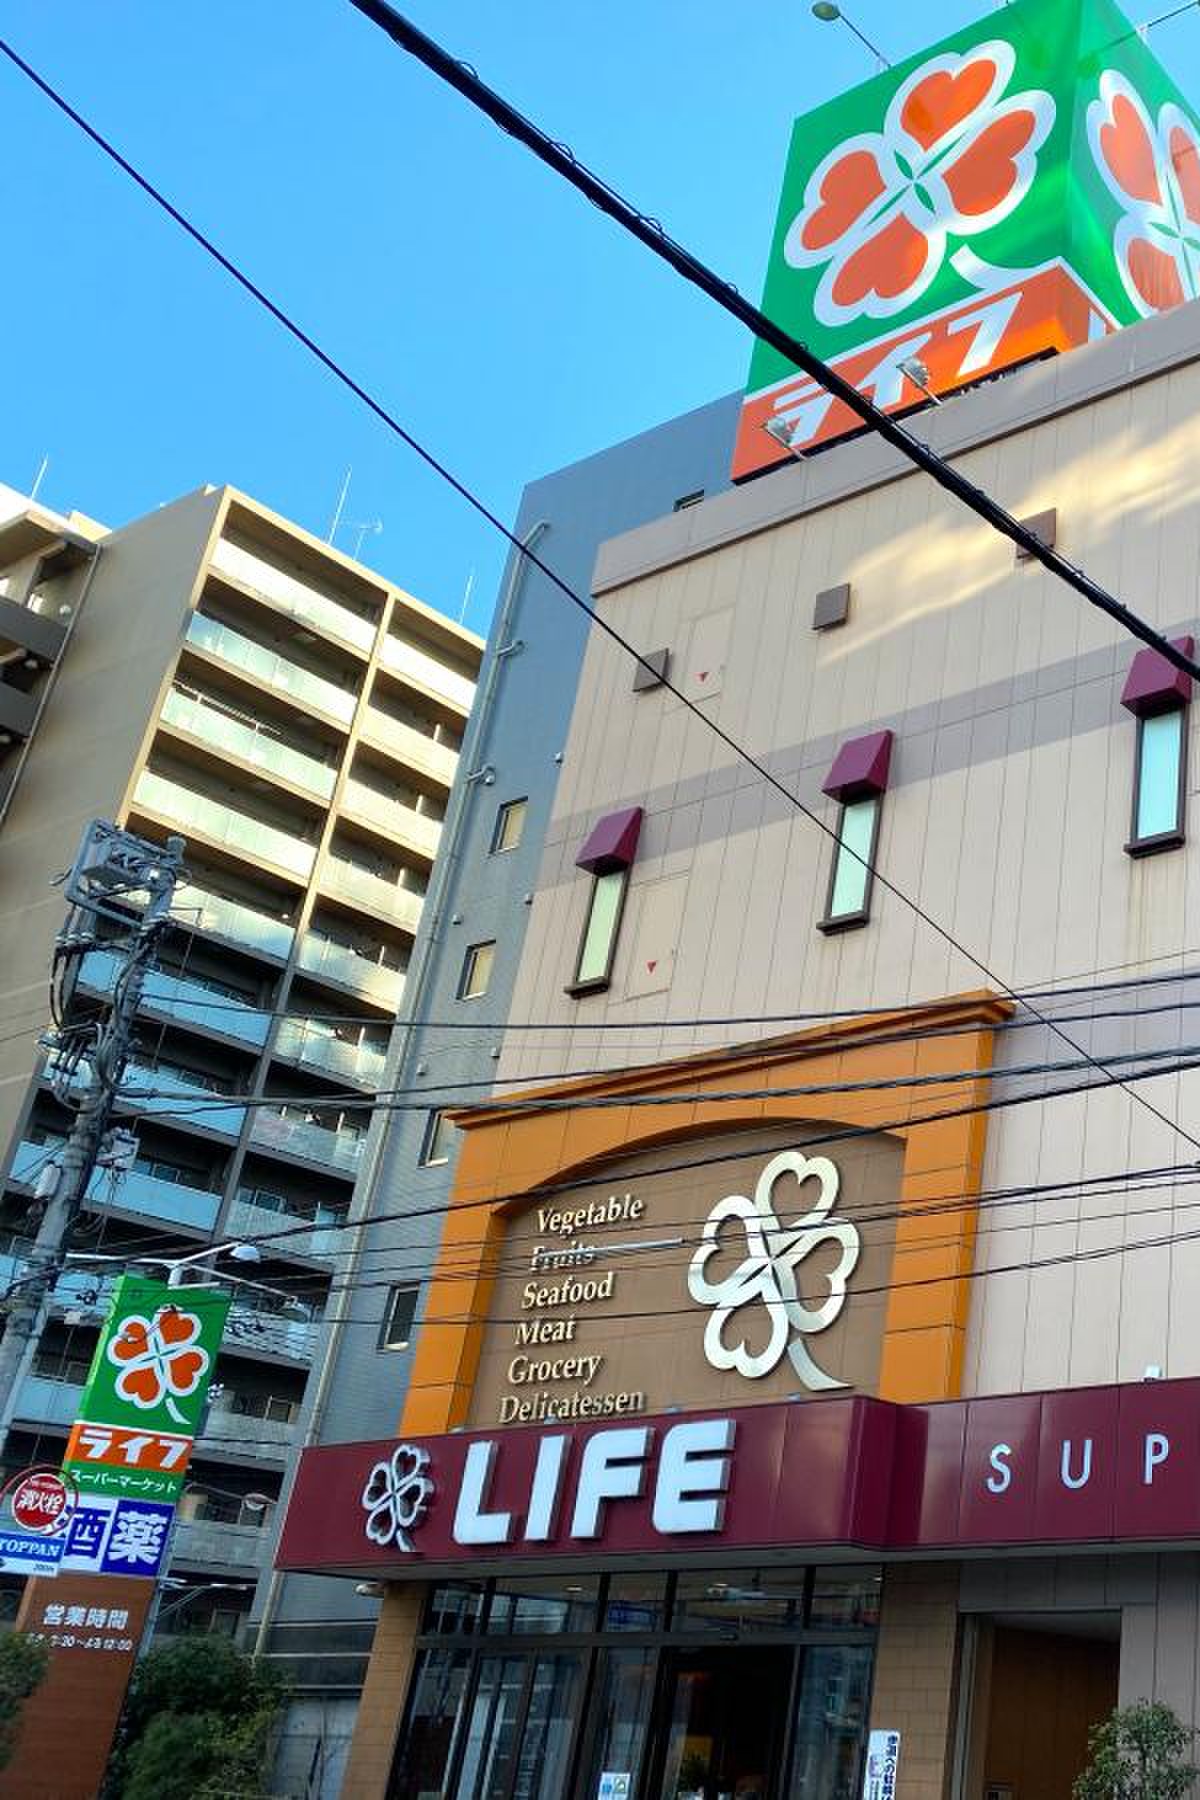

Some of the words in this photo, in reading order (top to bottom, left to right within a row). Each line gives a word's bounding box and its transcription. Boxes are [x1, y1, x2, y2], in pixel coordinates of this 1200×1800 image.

[537, 1194, 645, 1236] Vegetable
[529, 1241, 595, 1273] Fruits
[521, 1271, 615, 1310] Seafood
[513, 1314, 577, 1346] Meat
[508, 1353, 602, 1386] Grocery
[499, 1390, 645, 1425] Delicatessen
[79, 1428, 189, 1469] ライフ
[70, 1468, 178, 1494] スーパーマーケット
[453, 1419, 736, 1545] LIFE
[107, 1510, 169, 1565] 薬
[43, 1602, 129, 1631] 営業時間
